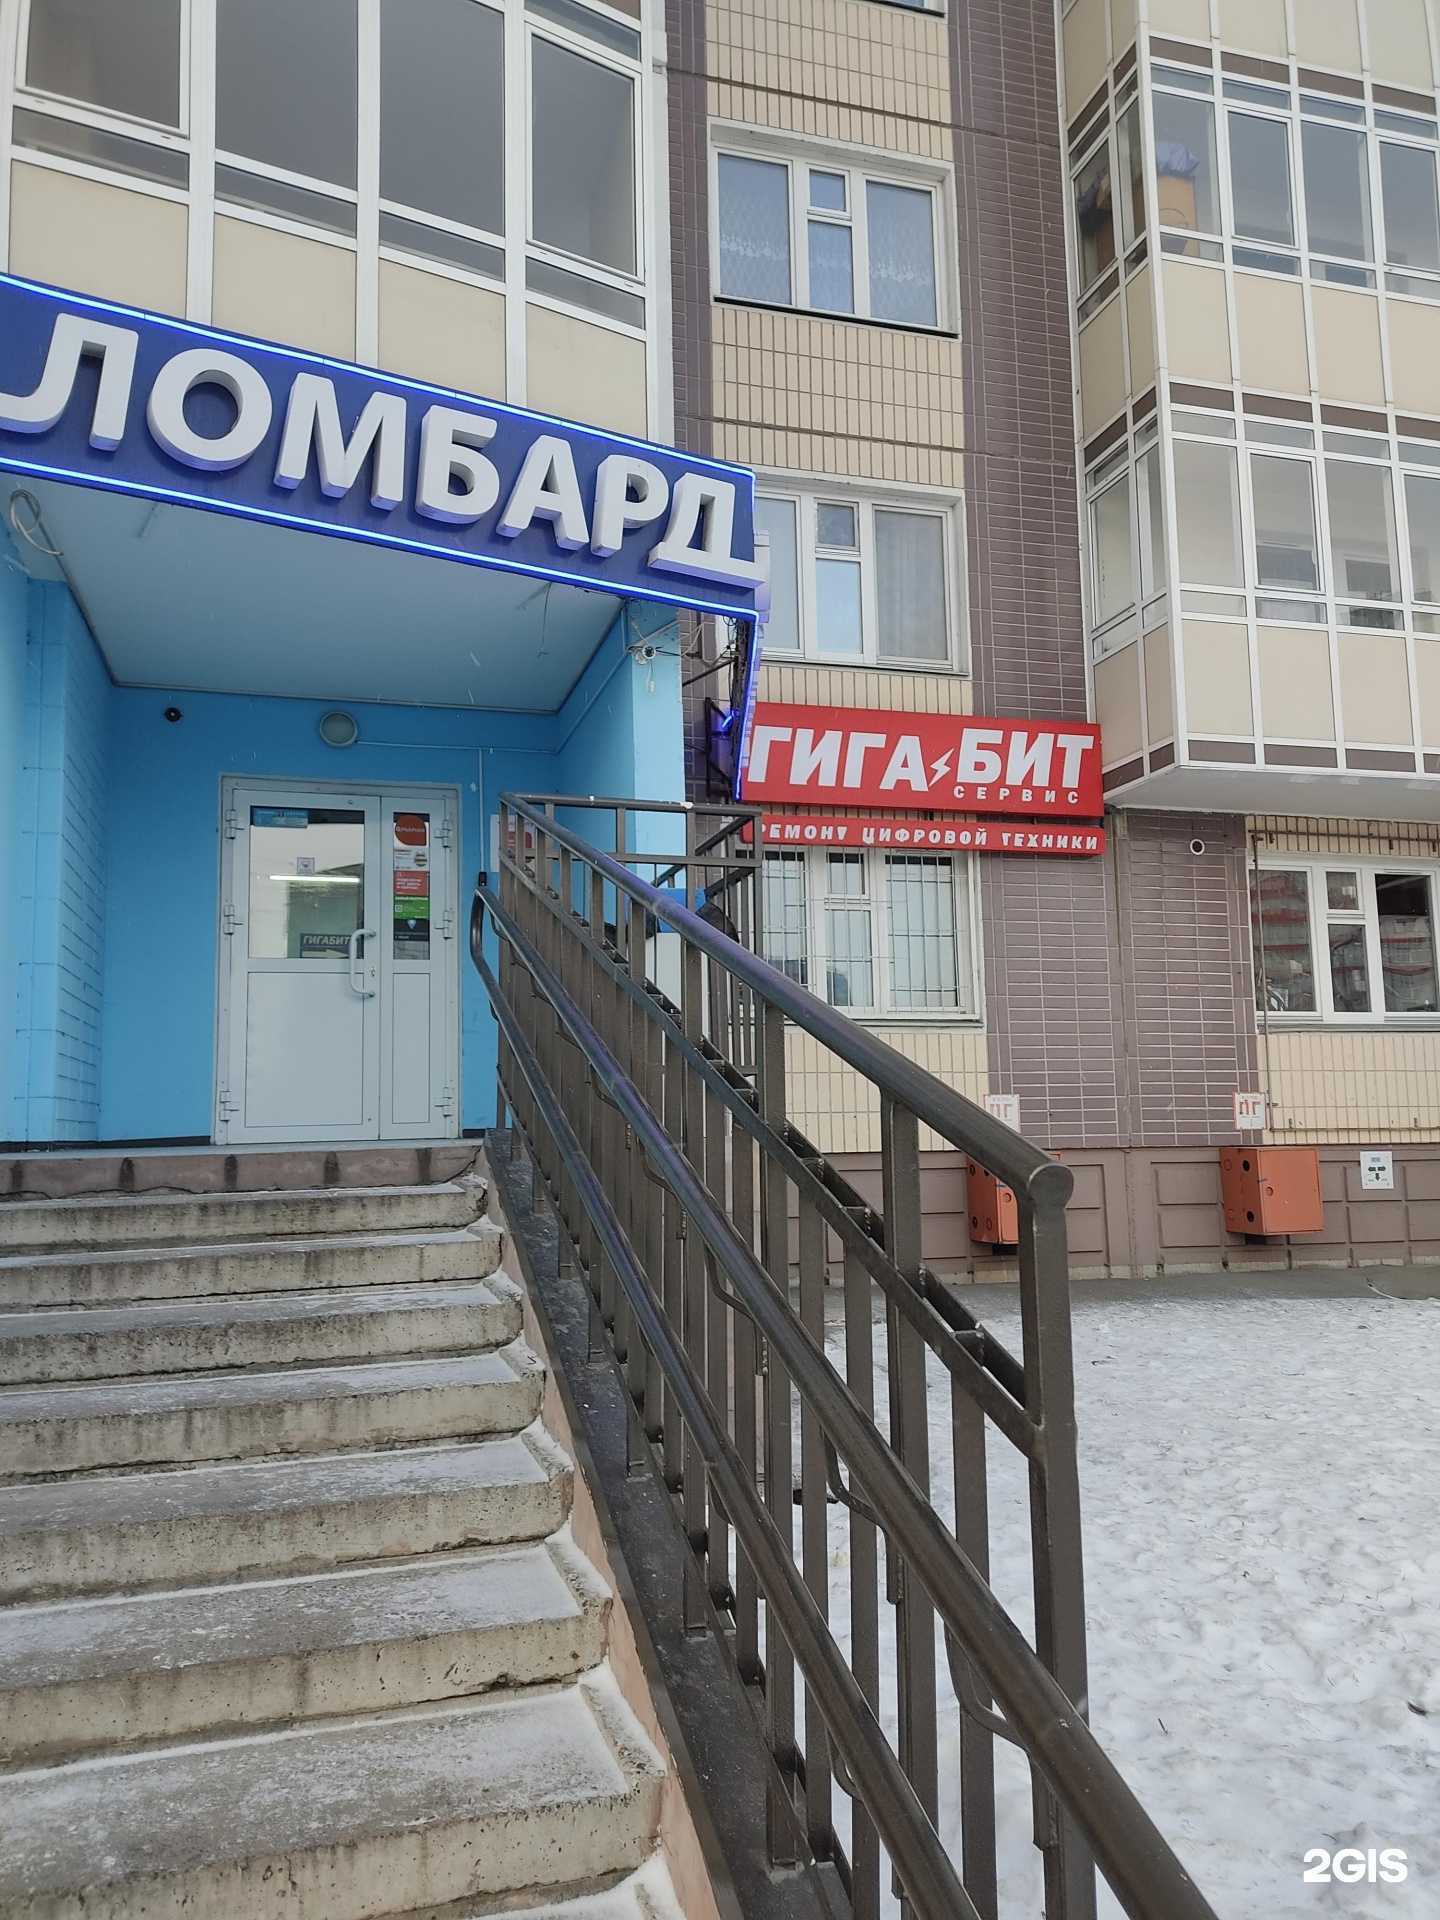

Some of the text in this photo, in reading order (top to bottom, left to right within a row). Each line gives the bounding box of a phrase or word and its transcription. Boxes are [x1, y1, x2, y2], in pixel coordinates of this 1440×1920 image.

[0, 312, 767, 588] ЛОМБАРД
[748, 725, 1094, 791] ГИГА БИТ
[953, 785, 1079, 804] СЕРВИС
[862, 826, 987, 845] ЦИФРОВОЙ
[1001, 832, 1097, 850] ТЕХНИКИ
